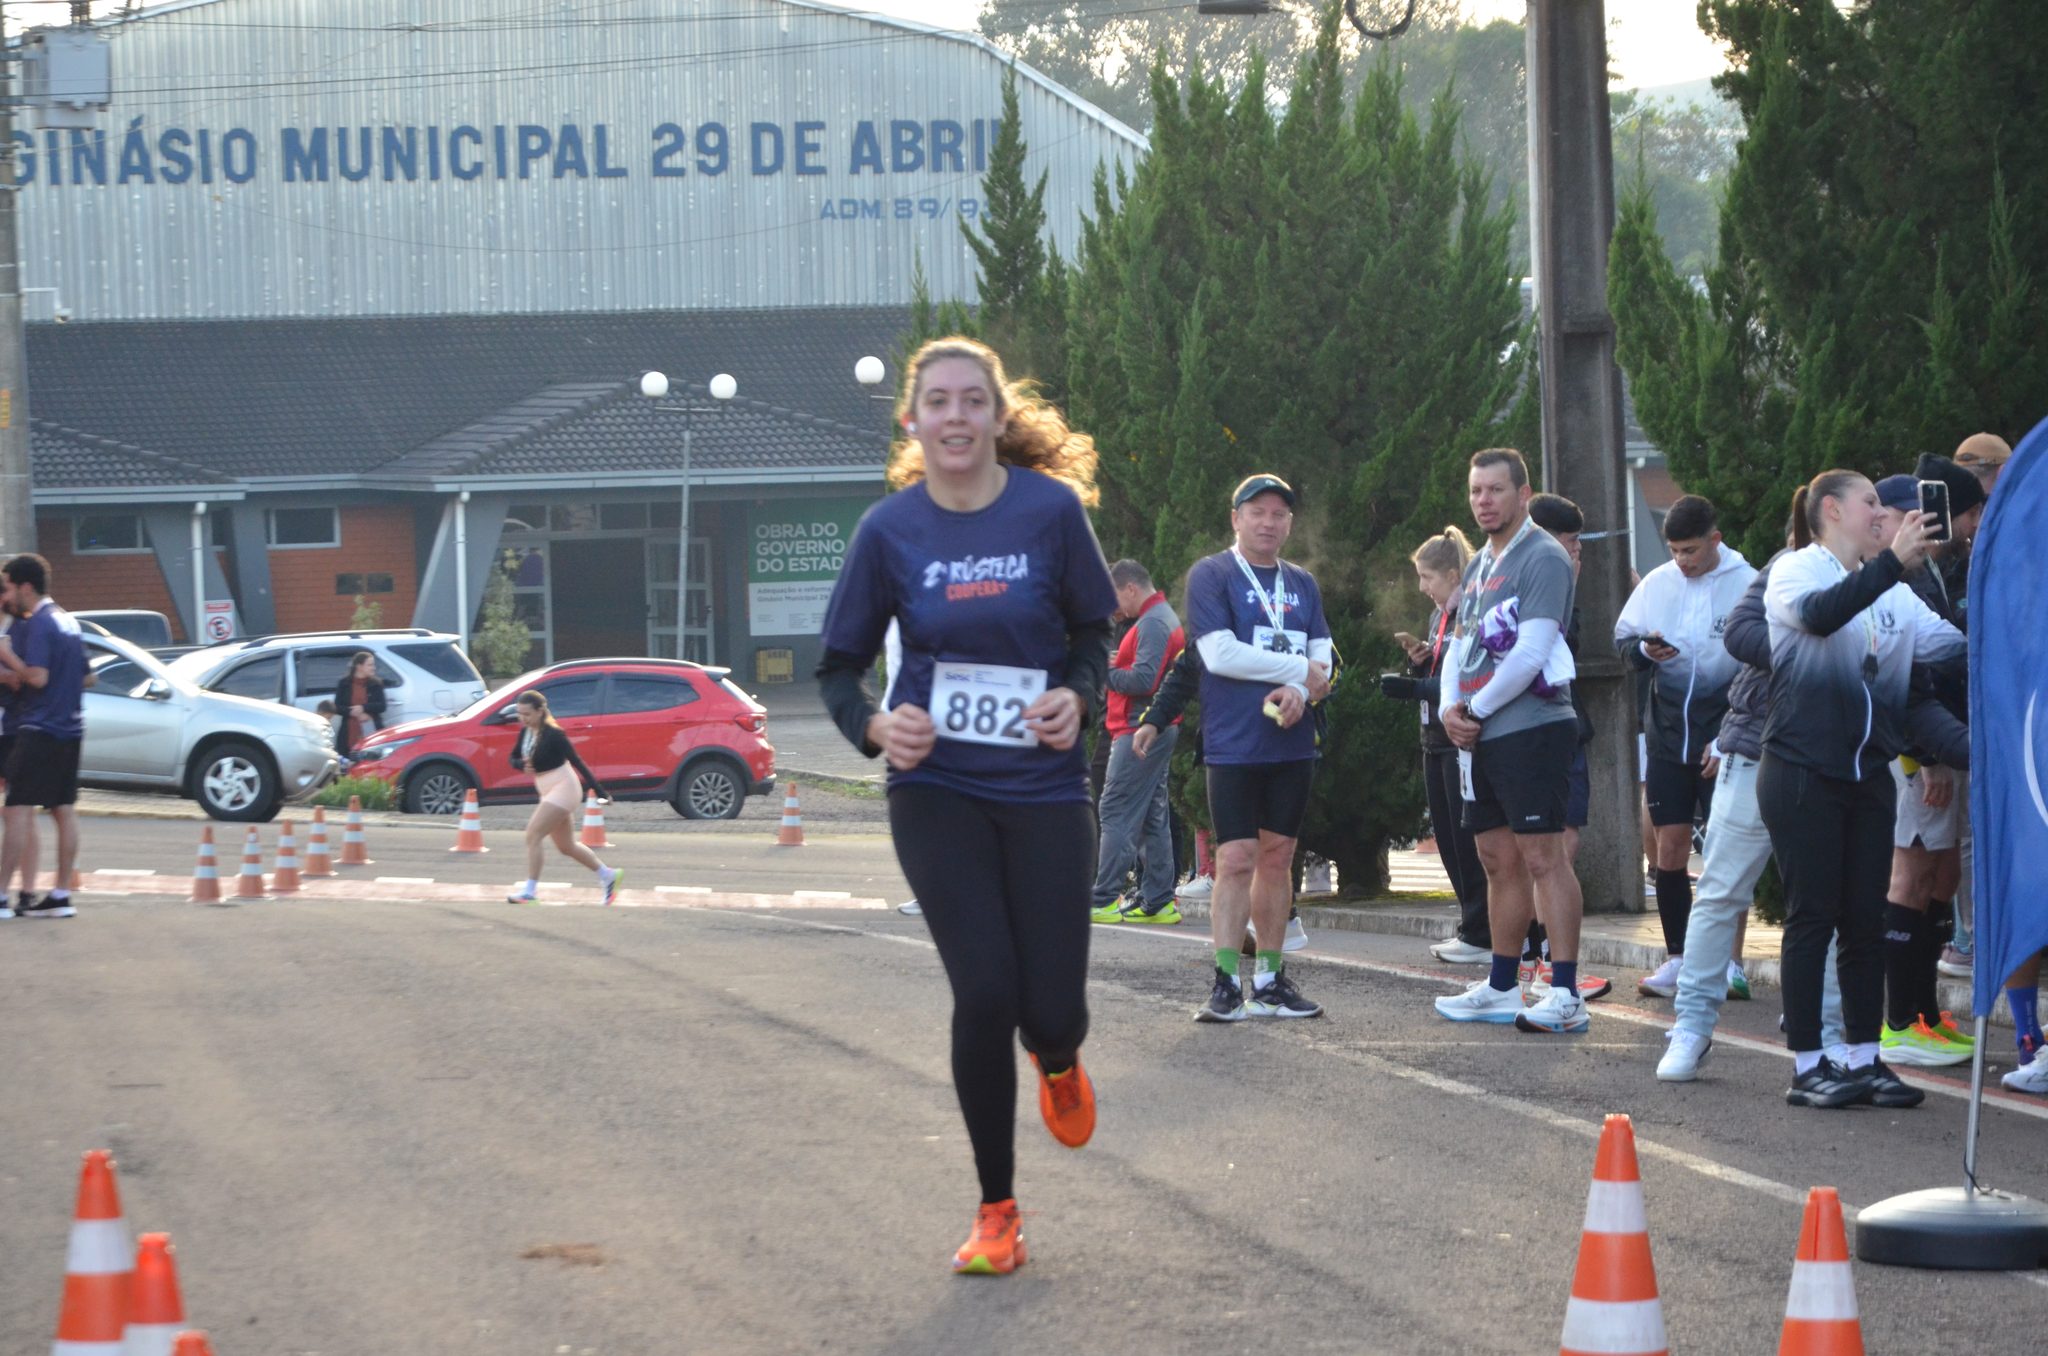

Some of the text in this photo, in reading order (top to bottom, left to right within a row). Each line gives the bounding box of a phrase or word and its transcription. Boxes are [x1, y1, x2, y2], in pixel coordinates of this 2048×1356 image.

[12, 114, 1002, 186] GINÁSIO MUNICIPAL 29 DE ABRI
[756, 522, 839, 538] OBRA DO
[756, 539, 845, 555] GOVERNO
[757, 558, 784, 573] DO
[949, 553, 1028, 582] RÚSTICA
[946, 690, 1026, 739] 882
